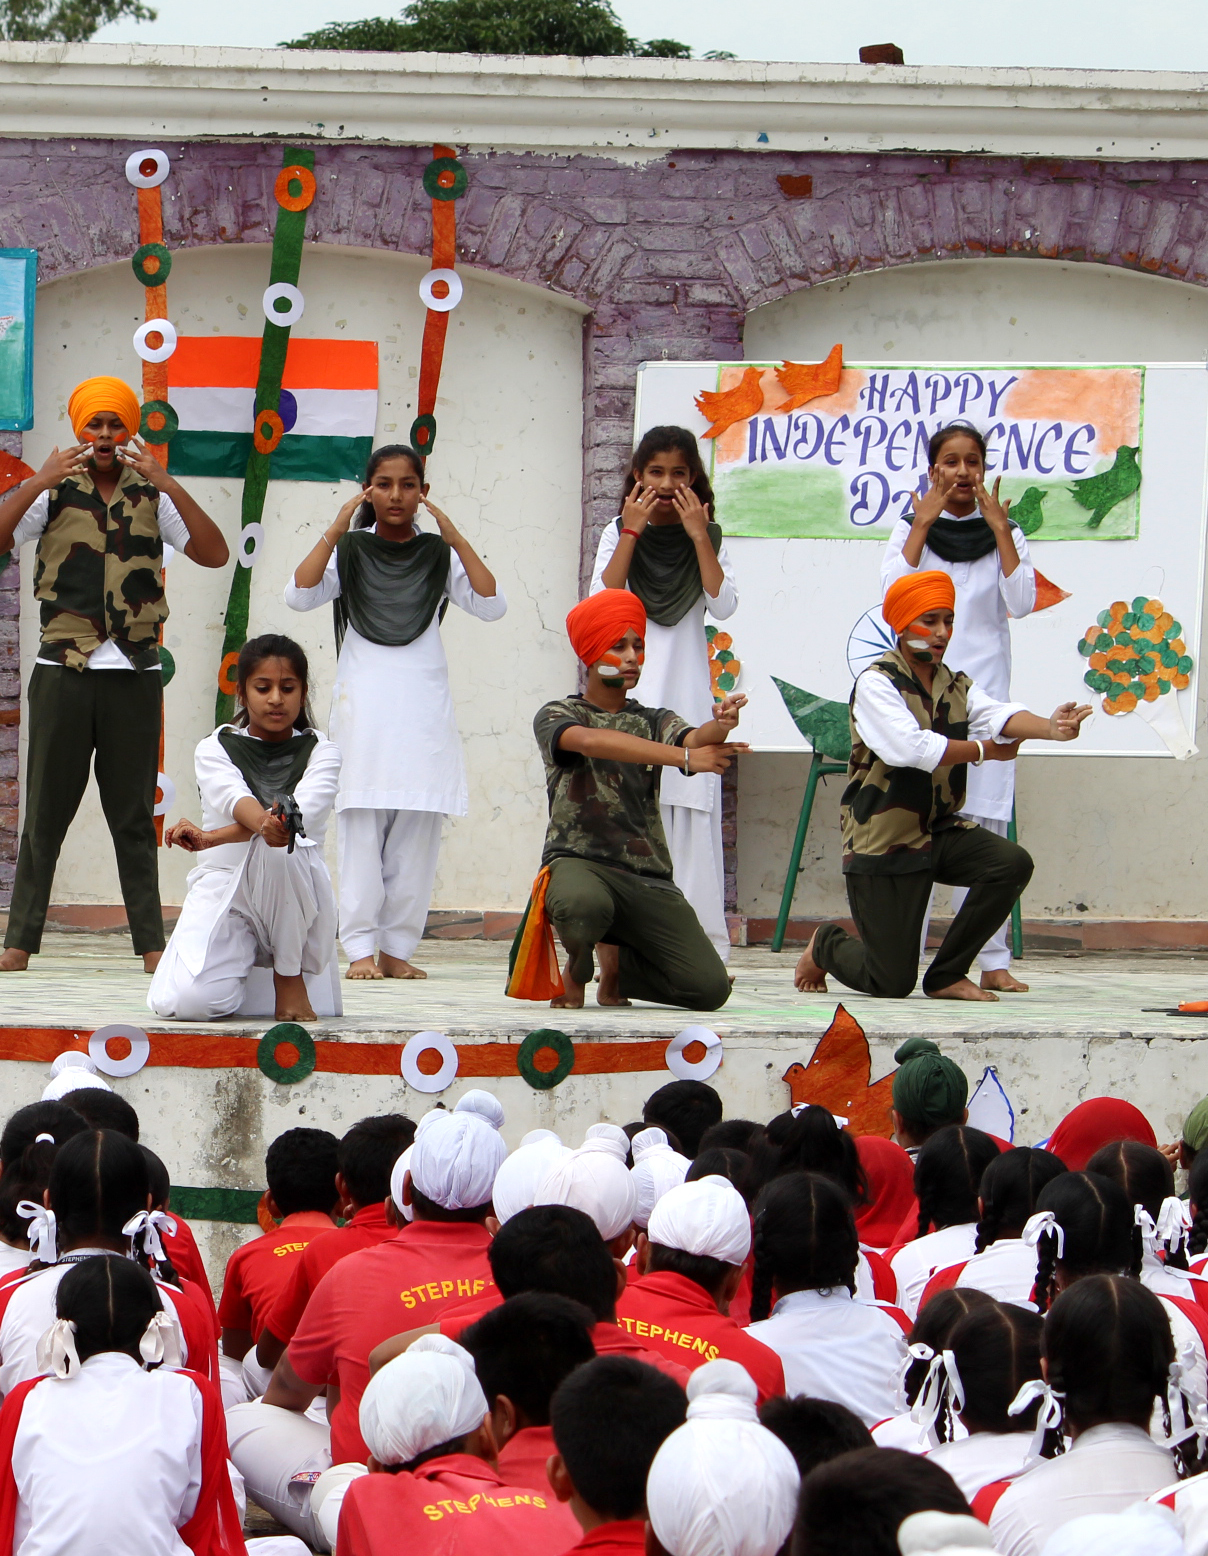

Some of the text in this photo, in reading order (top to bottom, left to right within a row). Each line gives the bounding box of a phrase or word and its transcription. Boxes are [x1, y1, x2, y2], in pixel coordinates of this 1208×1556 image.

[859, 370, 1019, 418] HAPPY
[747, 412, 1096, 475] INDEPENENCE
[849, 470, 930, 526] DA
[400, 1278, 495, 1309] STEPHE
[423, 1492, 547, 1521] STEPHENS
